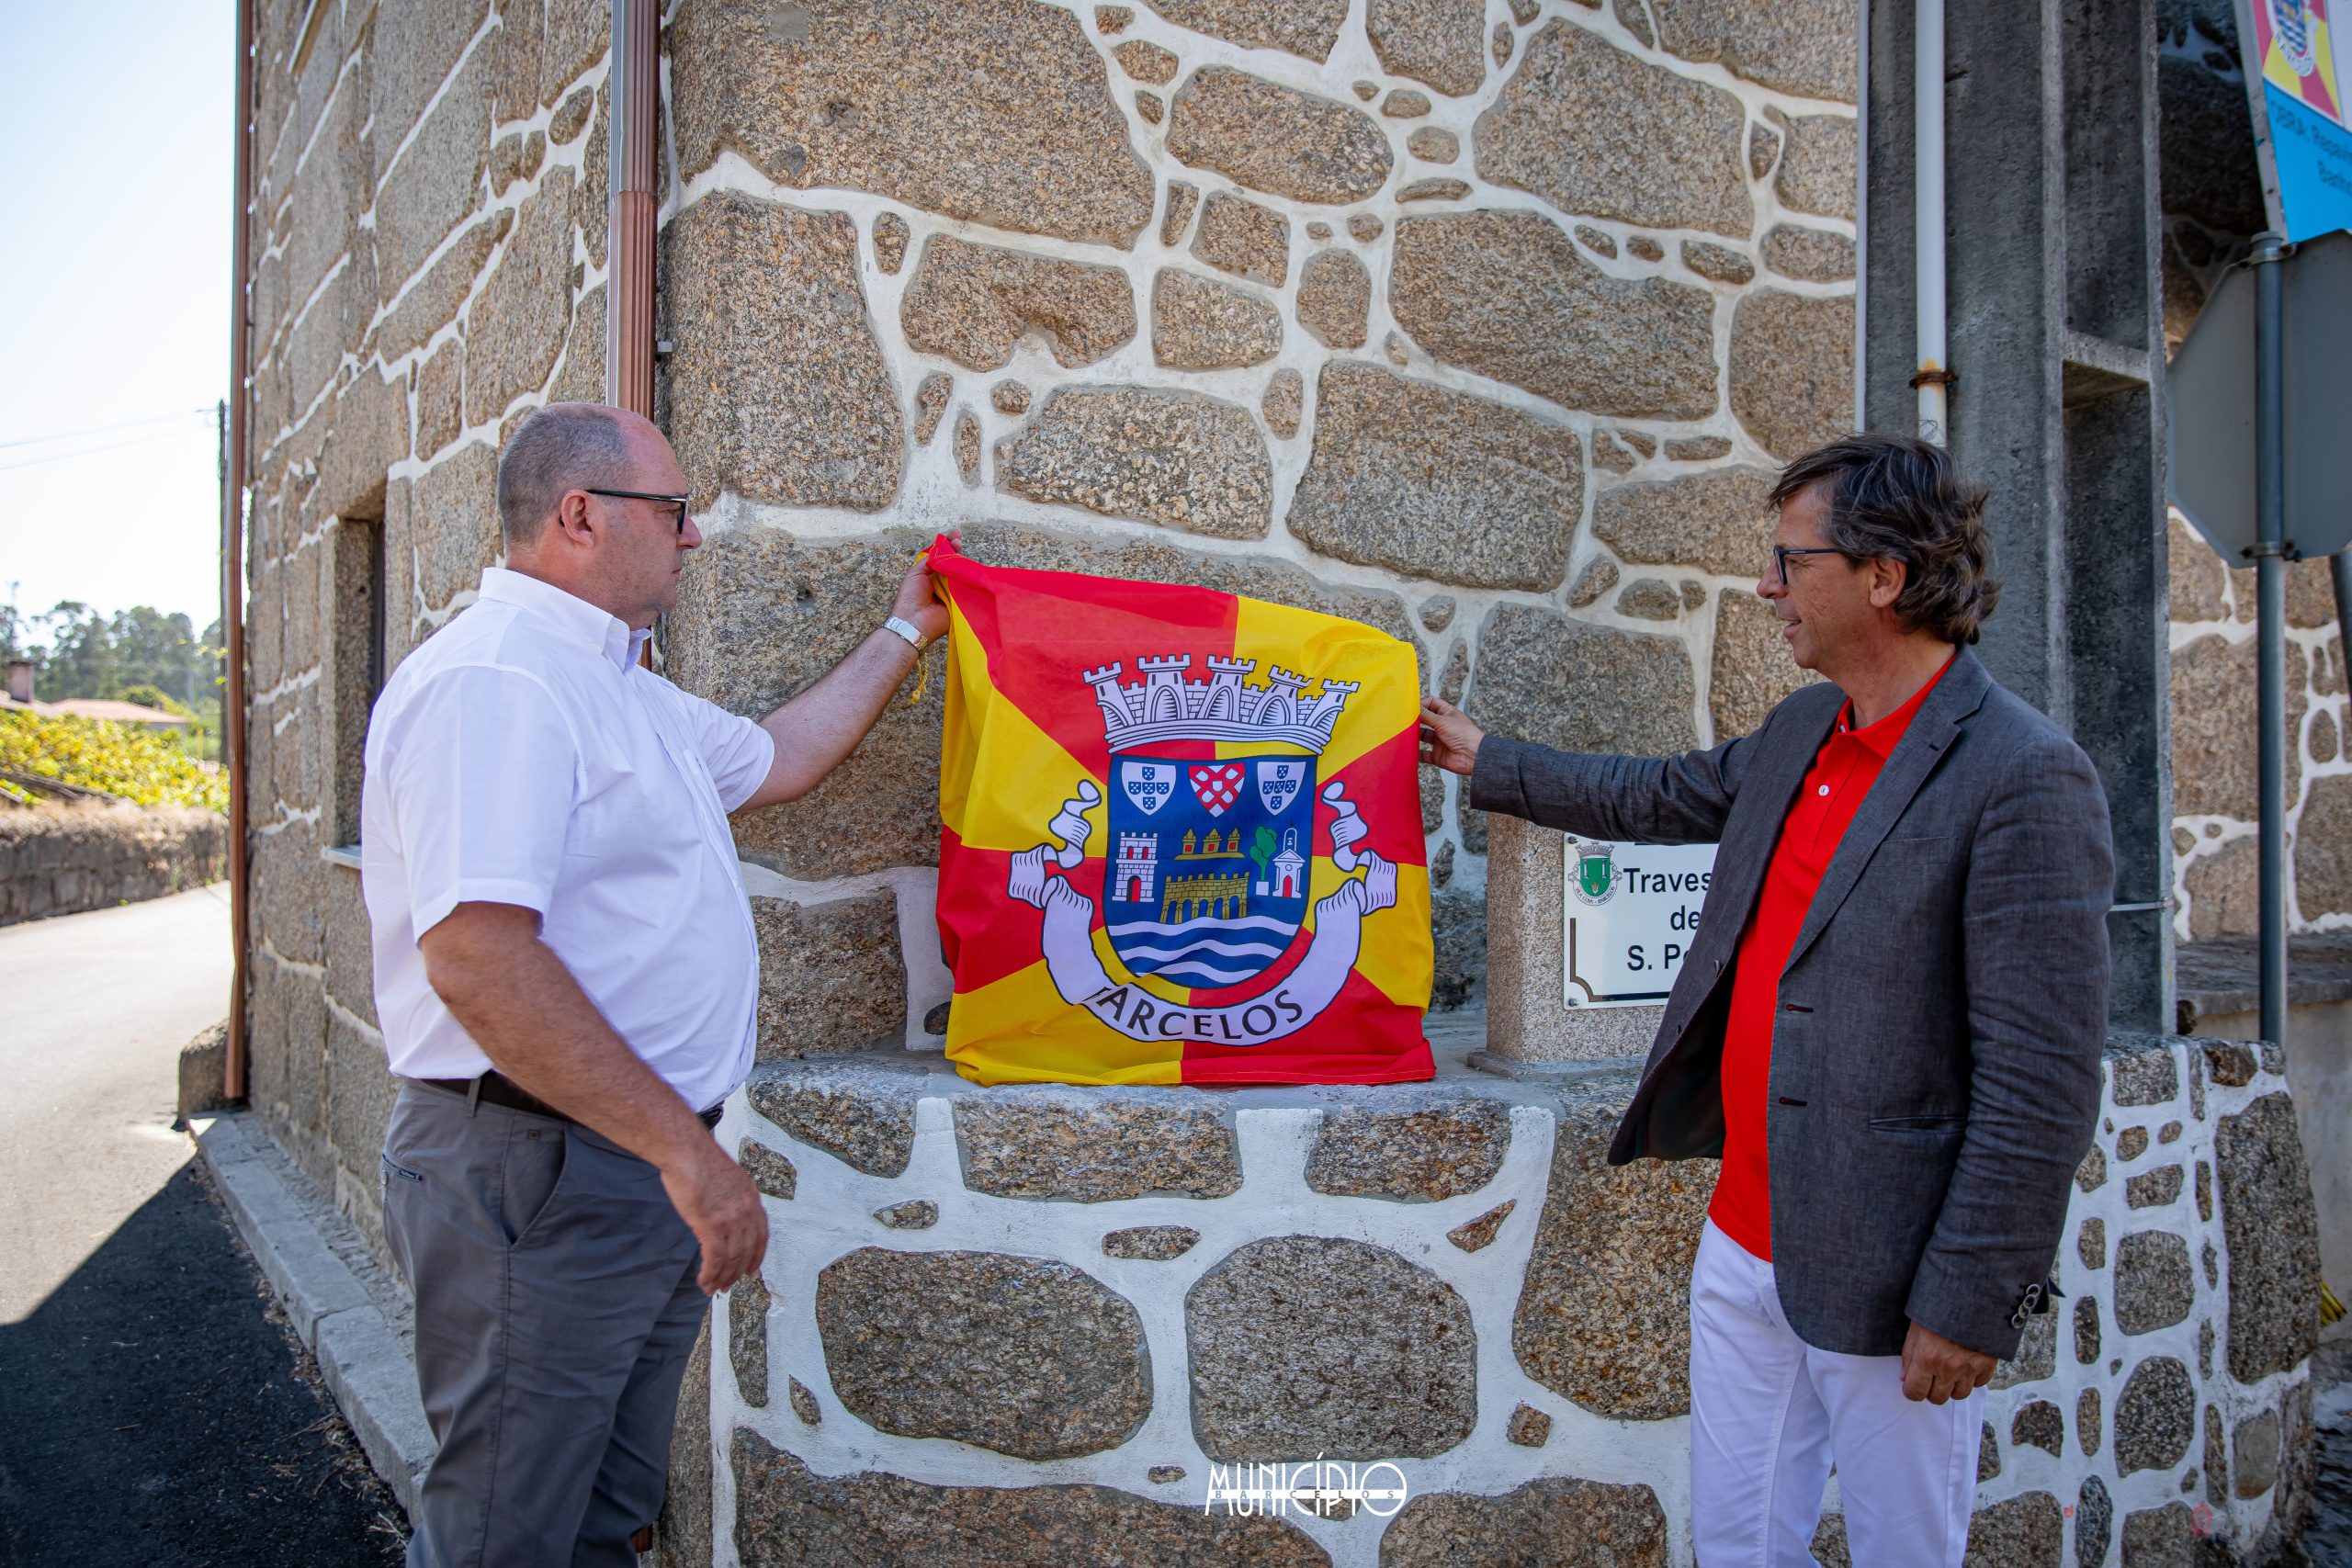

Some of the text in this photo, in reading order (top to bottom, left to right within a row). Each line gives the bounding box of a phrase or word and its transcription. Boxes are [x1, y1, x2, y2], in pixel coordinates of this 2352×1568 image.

[1623, 867, 1713, 894] Traves
[1670, 905, 1700, 931] de
[1626, 943, 1690, 971] S. P
